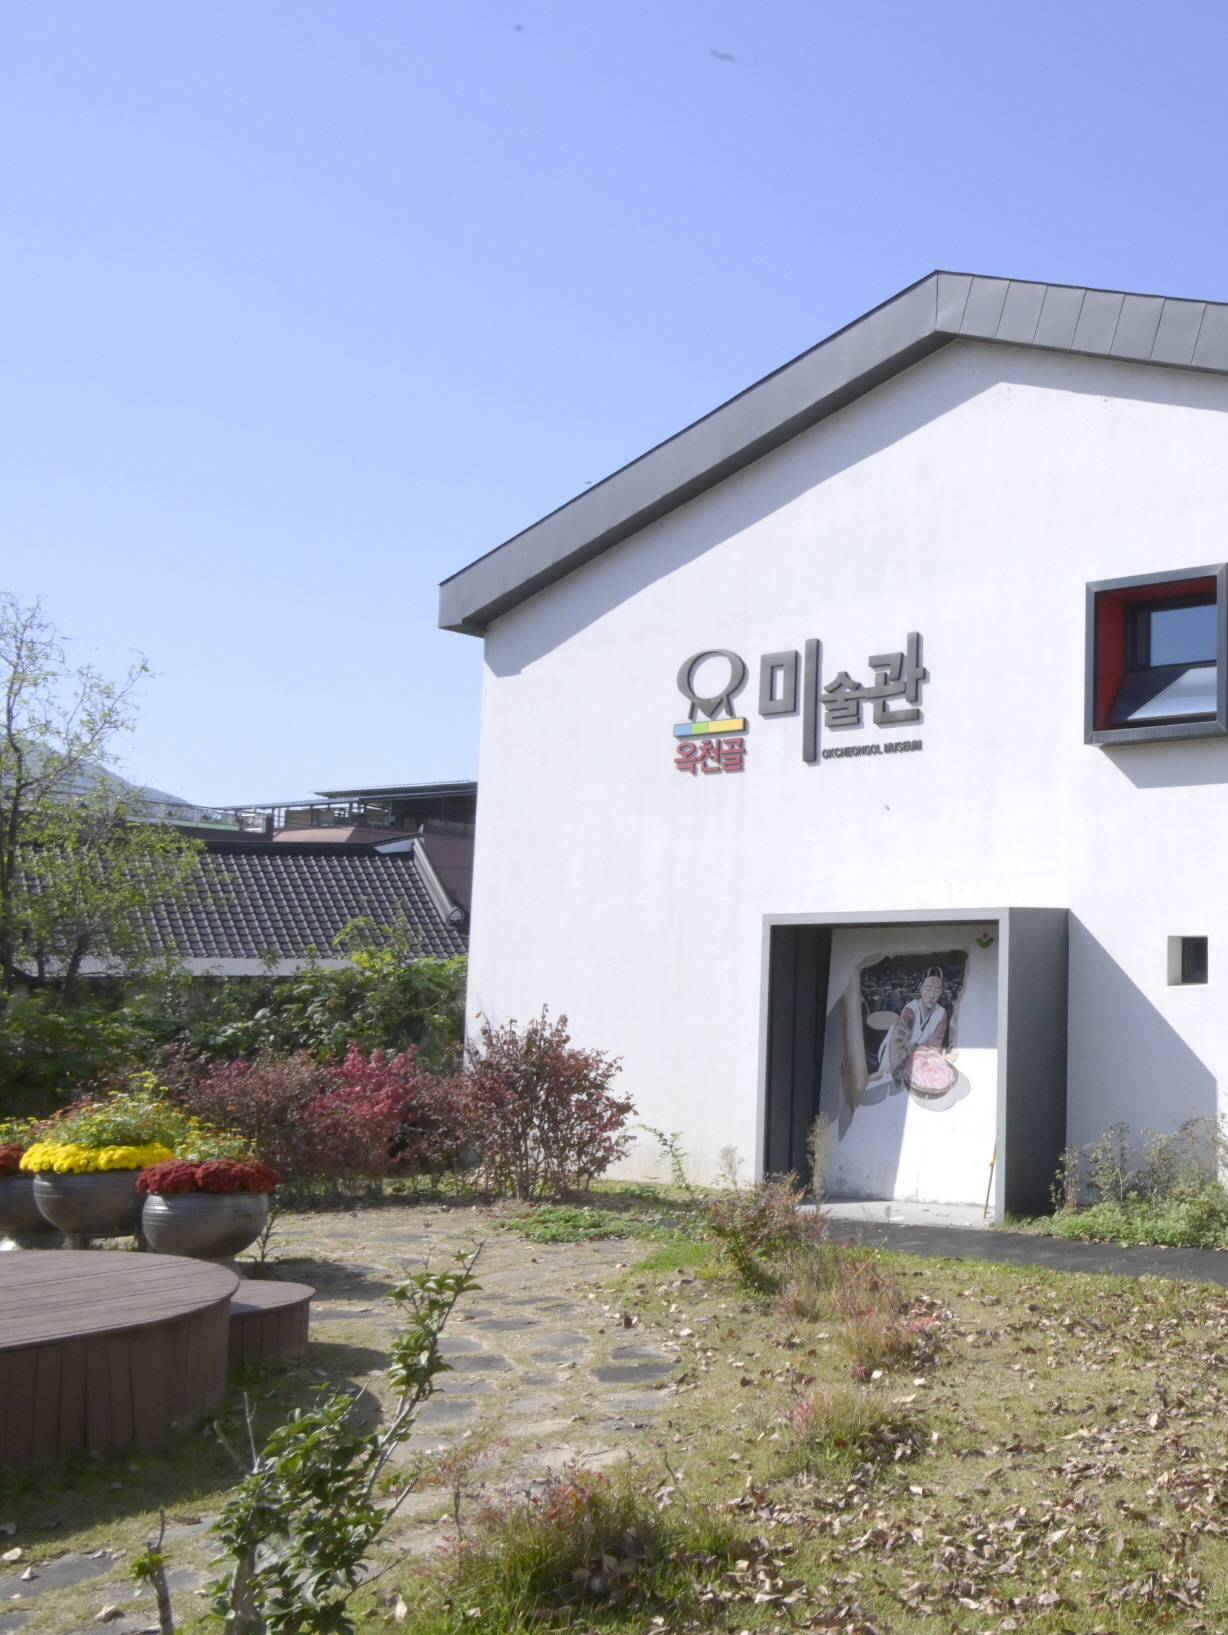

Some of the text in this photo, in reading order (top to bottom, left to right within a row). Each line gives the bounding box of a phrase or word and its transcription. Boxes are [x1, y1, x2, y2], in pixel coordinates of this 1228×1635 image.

[673, 737, 746, 774] 옥천골
[822, 739, 923, 760] OKCHEONGOL MUSEUM
